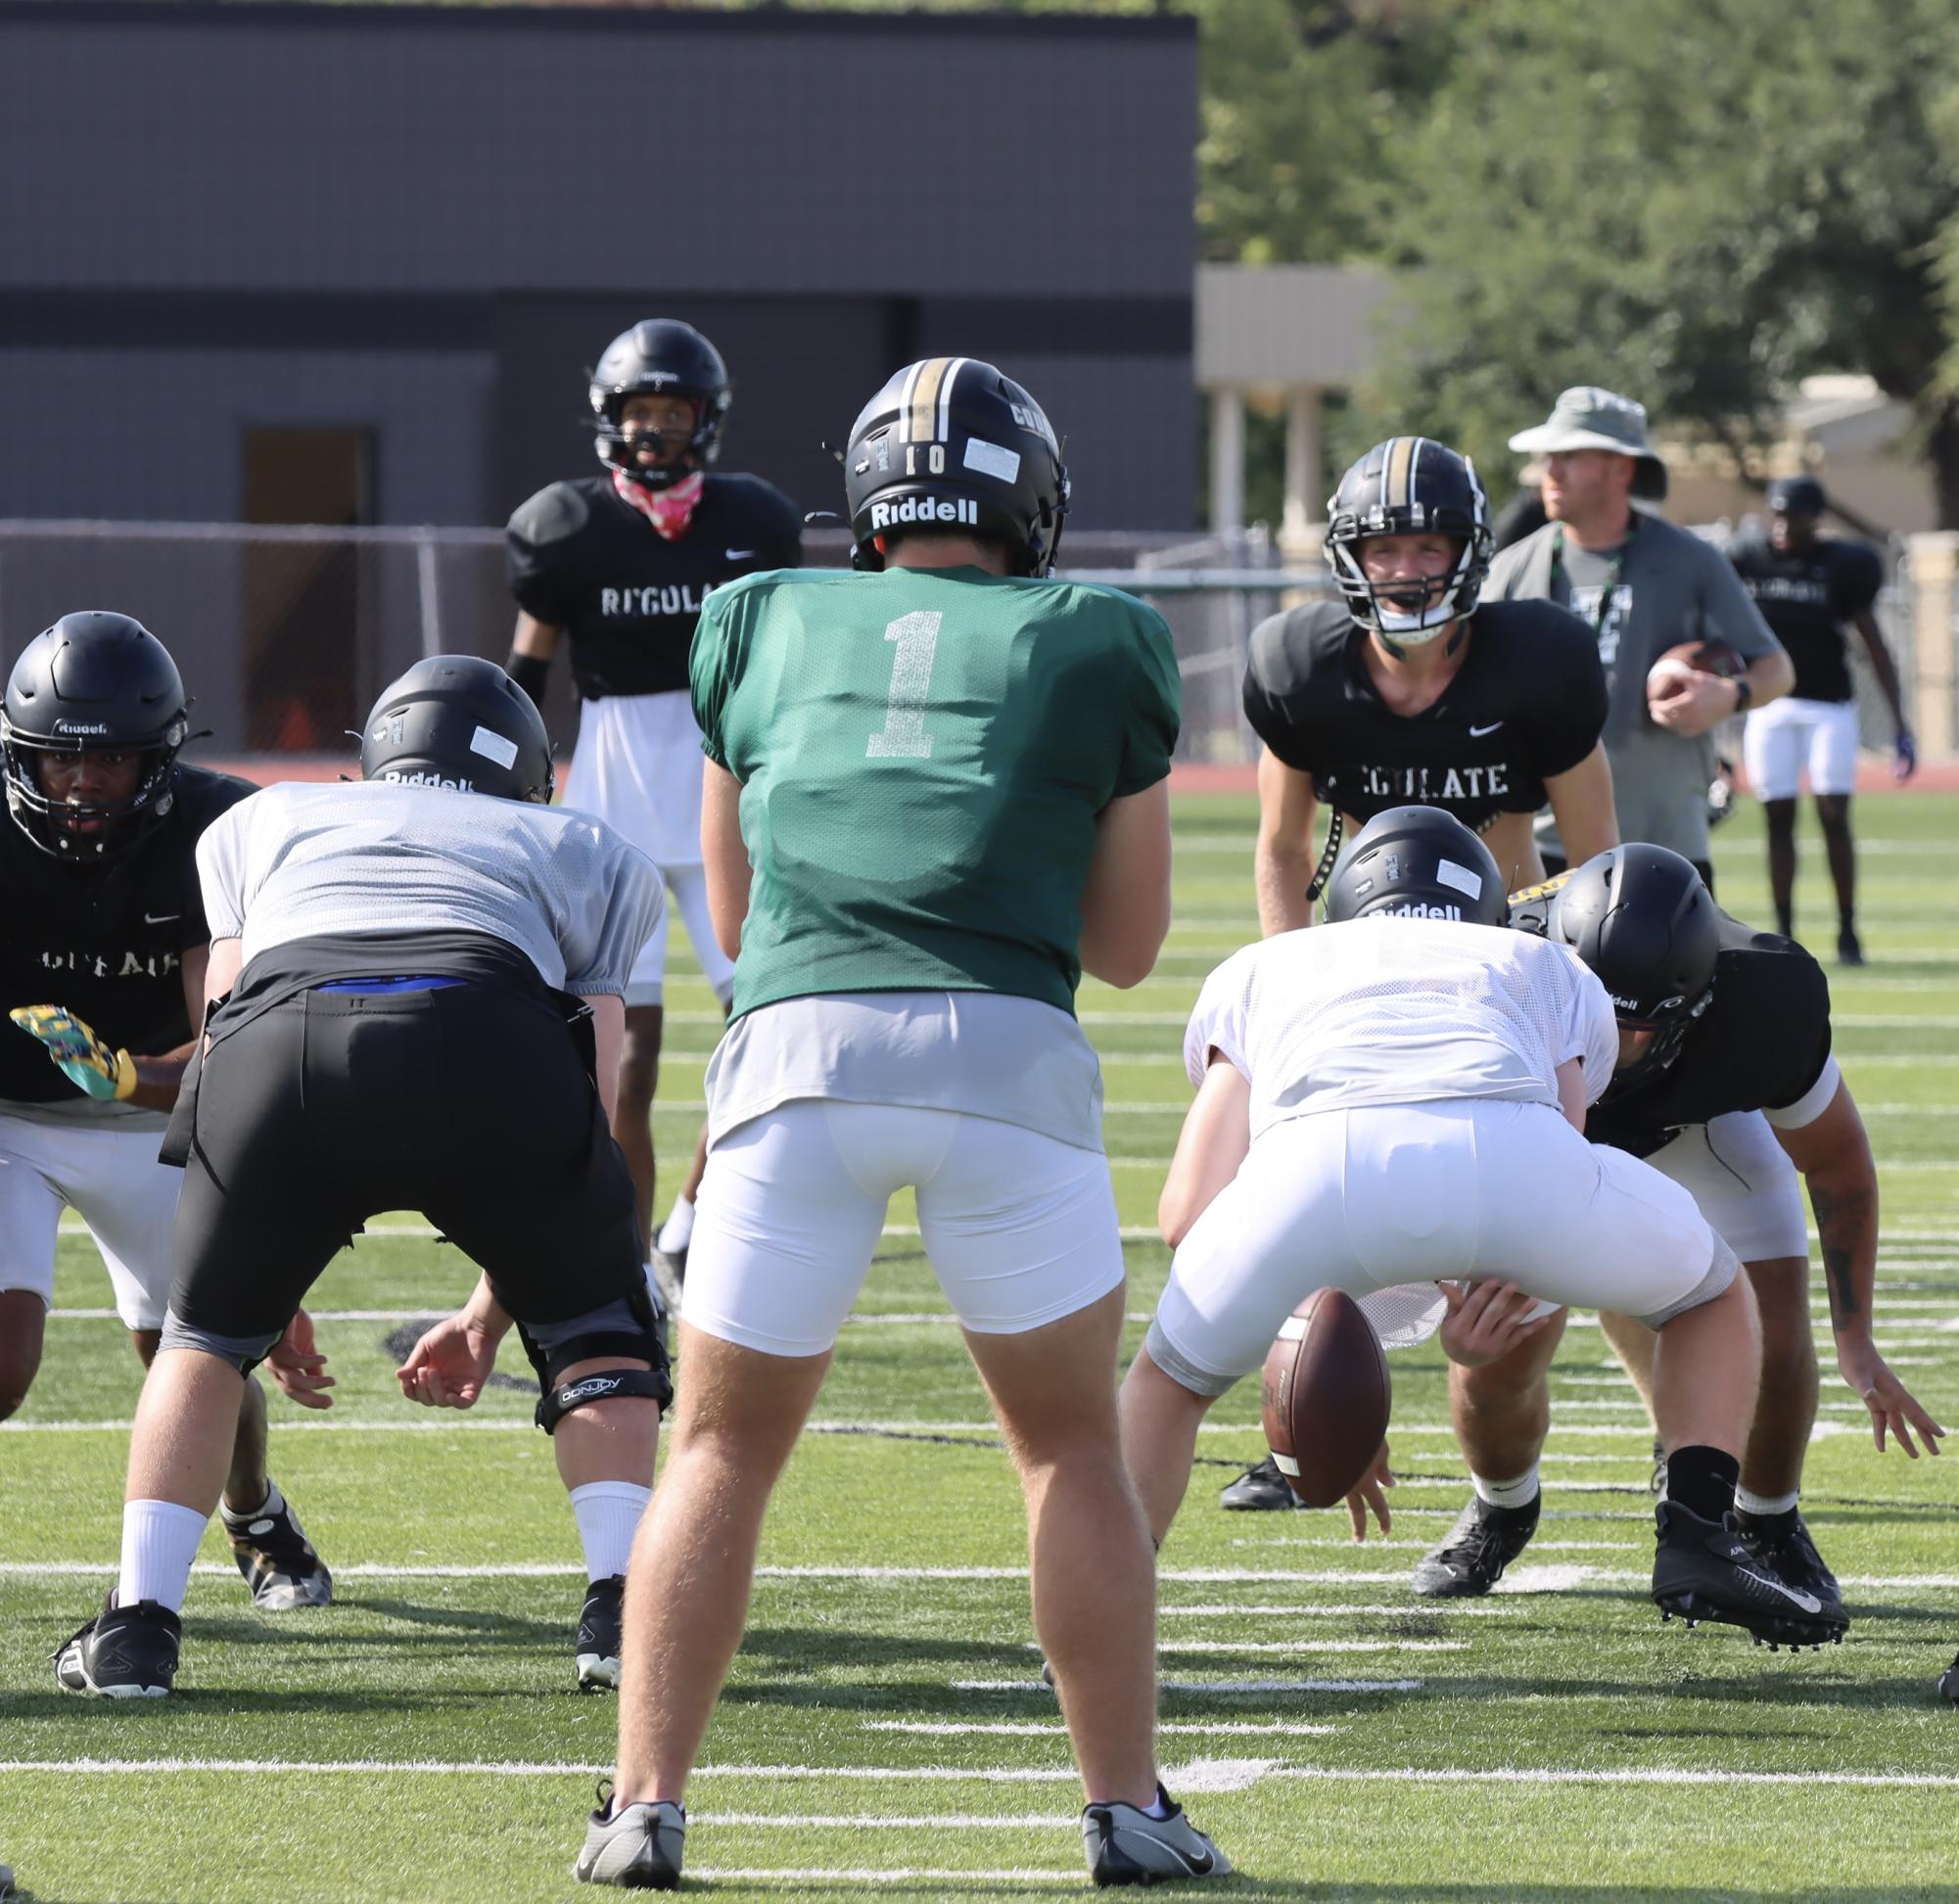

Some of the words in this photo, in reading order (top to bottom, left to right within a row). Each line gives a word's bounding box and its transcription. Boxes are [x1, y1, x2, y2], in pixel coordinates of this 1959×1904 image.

[906, 444, 945, 476] 10
[870, 496, 978, 530] Riddell
[865, 610, 943, 758] 1
